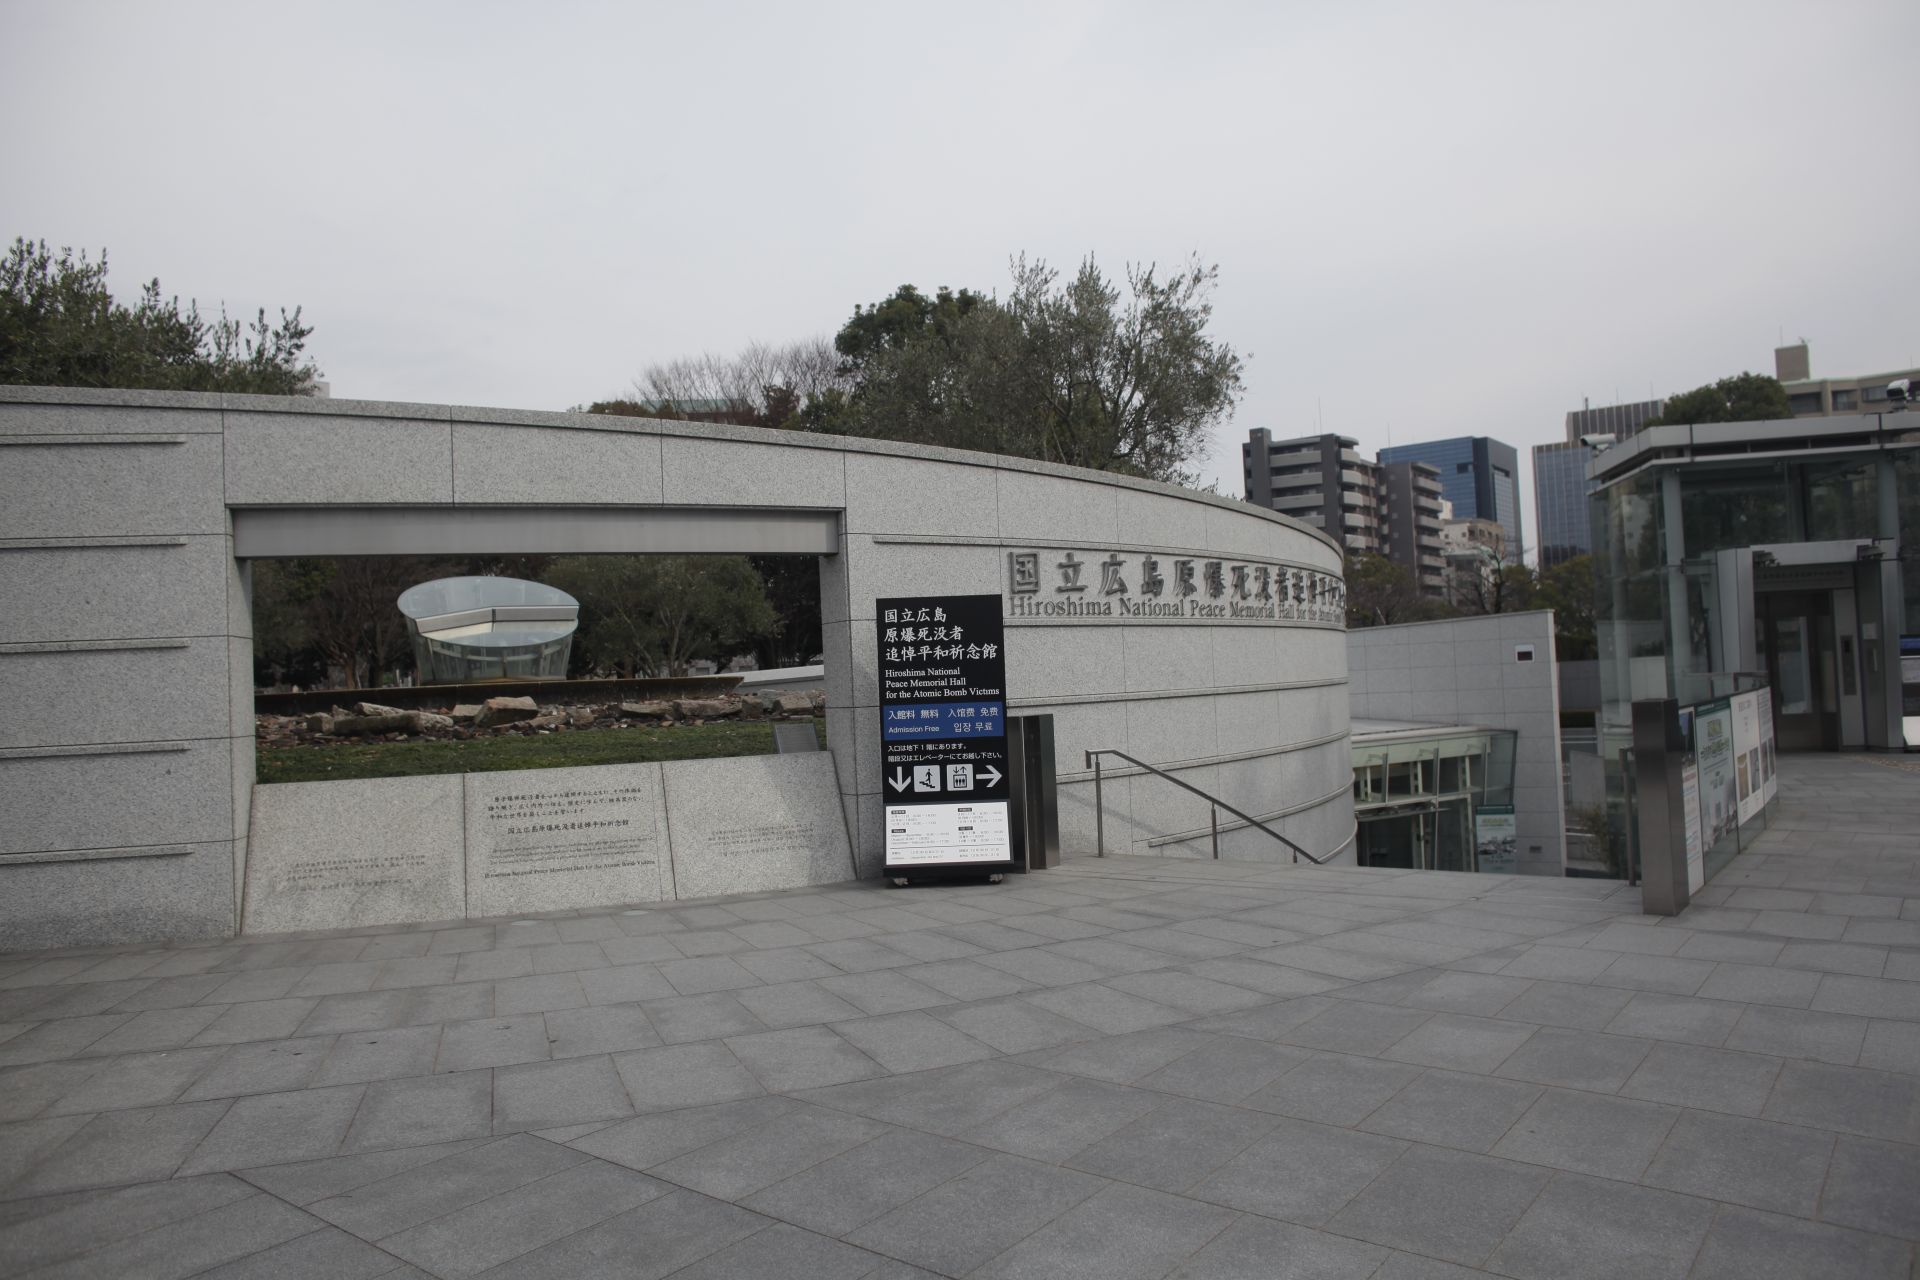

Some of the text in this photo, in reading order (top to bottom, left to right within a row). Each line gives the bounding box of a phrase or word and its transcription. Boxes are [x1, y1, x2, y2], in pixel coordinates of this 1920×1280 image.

[1009, 594, 1112, 616] Hiroshima
[1119, 597, 1185, 617] National
[1190, 600, 1226, 617] Peace
[1229, 601, 1275, 619] Memorial
[885, 607, 947, 623] 国立広島
[884, 625, 963, 643] 原爆死没者
[885, 643, 998, 662] 追悼平和祈念館
[885, 667, 960, 678] Hiroshima National
[886, 677, 966, 688] Peace Memorial Hall
[886, 687, 1000, 699] for the Atomic Bomb Victims
[888, 709, 939, 720] 入館料 無料
[948, 707, 999, 718] 入馆费 免费
[888, 726, 923, 734] Admission
[953, 722, 993, 733] 입장 무료
